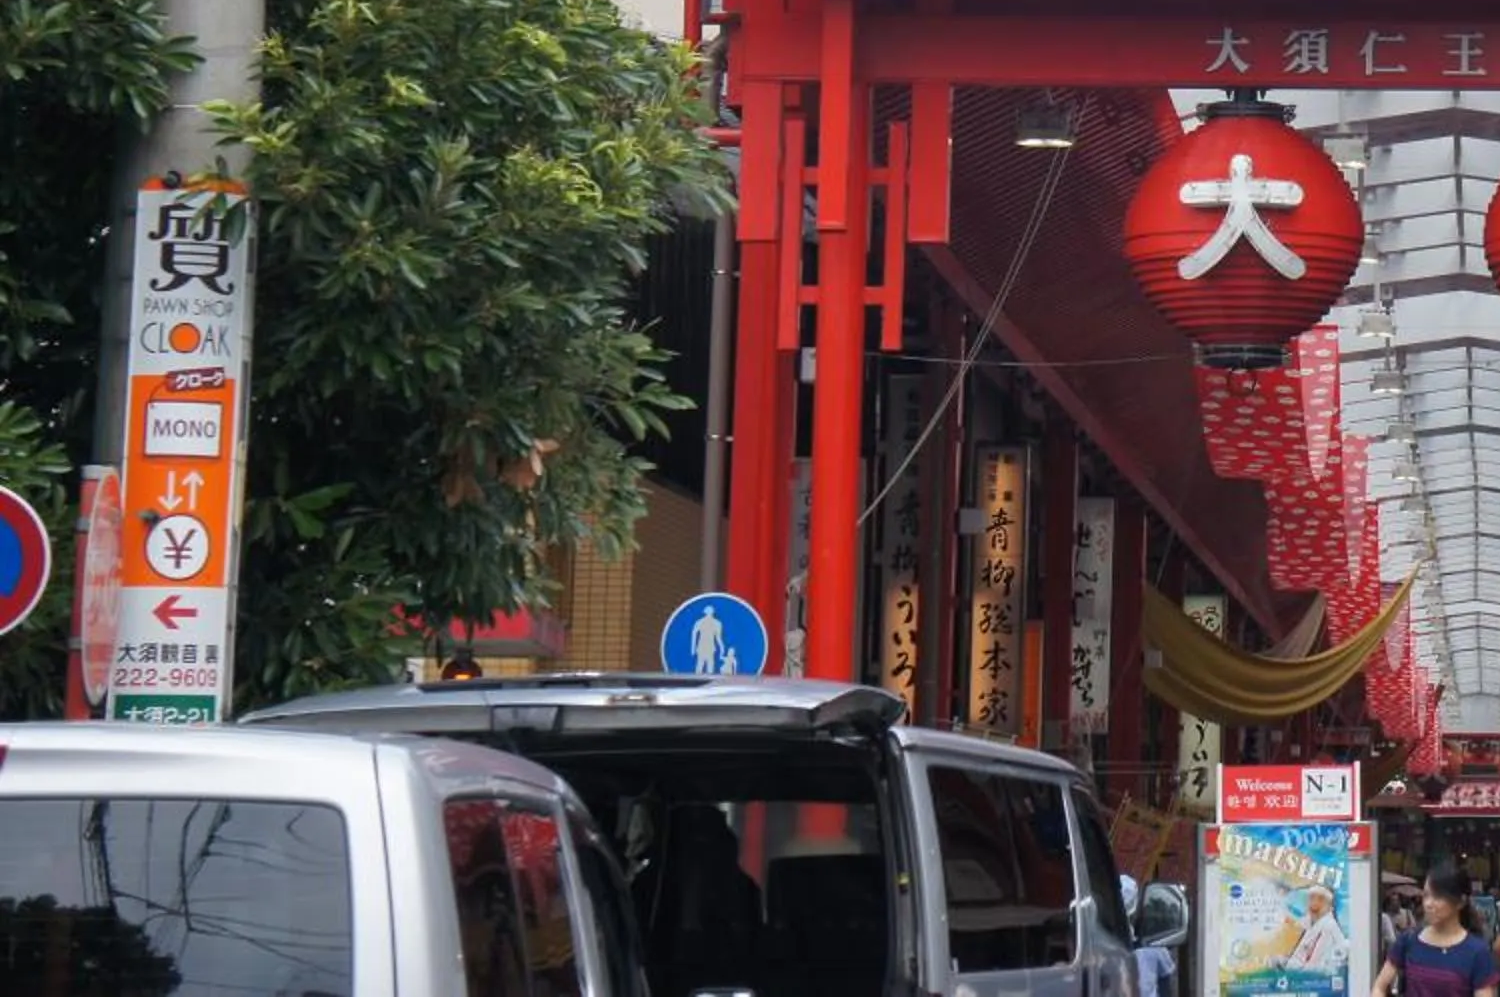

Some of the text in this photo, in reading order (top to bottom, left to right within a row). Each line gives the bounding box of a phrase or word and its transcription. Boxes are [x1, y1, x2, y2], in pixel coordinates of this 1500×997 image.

[1177, 153, 1307, 280] 大
[148, 203, 235, 295] 質
[143, 297, 234, 317] PAWN SHOP
[175, 371, 225, 390] クローク
[153, 418, 217, 438] MONO
[117, 643, 198, 663] 大須観音
[114, 668, 218, 687] 222-9609
[1235, 778, 1293, 792] Welcome
[1305, 774, 1347, 794] N-1
